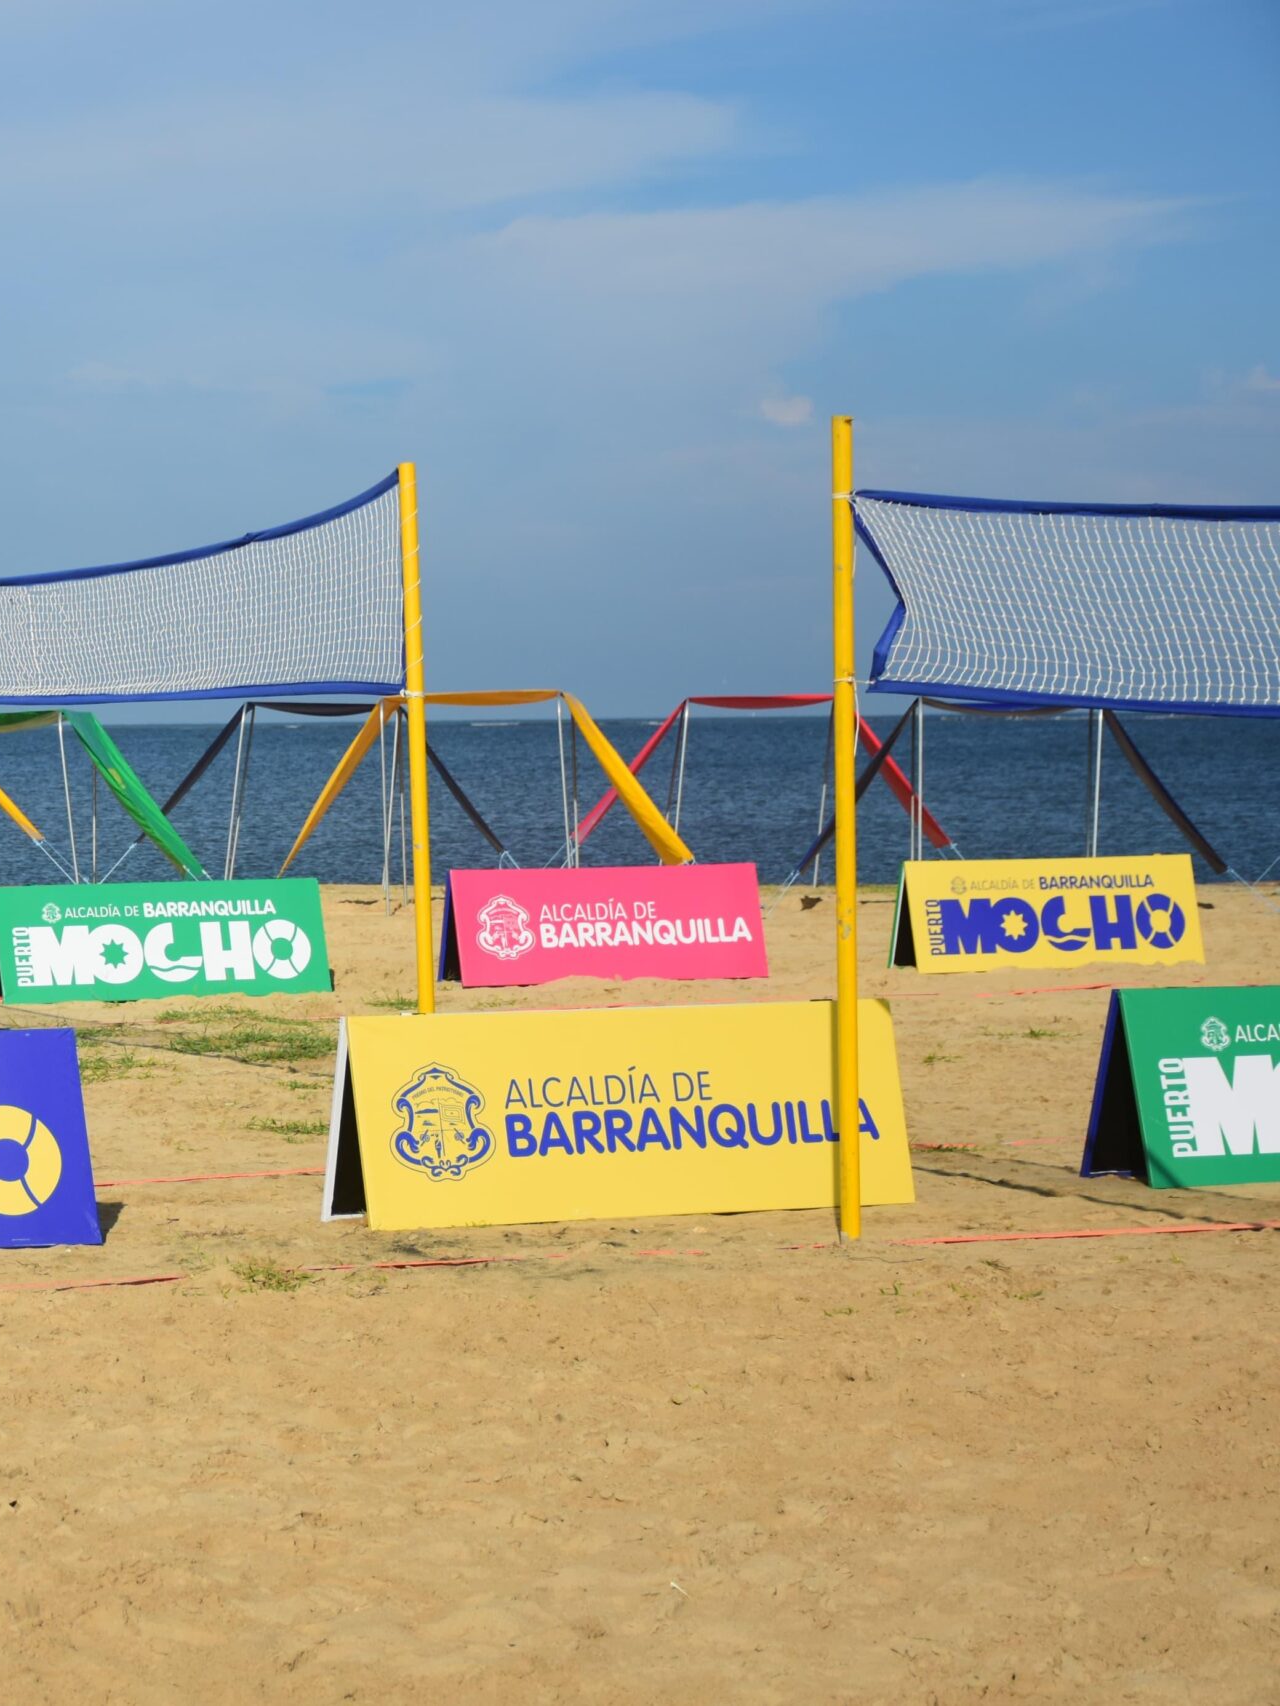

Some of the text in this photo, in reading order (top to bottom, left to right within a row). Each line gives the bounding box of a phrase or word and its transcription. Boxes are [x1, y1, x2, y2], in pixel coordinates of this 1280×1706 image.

[970, 874, 1154, 891] ALCALDÍA DE BARRANQUILLA
[64, 899, 276, 919] ALCALDÍA DE BARRANQUILLA
[539, 897, 656, 922] ALCALDÍA DE
[926, 900, 945, 955] PUERTO
[940, 893, 1186, 955] MOCHO
[28, 919, 311, 986] MOCHO
[539, 917, 752, 948] BARRANQUILLA
[12, 927, 35, 987] PUERTO
[1235, 1022, 1280, 1044] ALCA
[505, 1066, 713, 1109] ALCALDÍA DE
[1158, 1058, 1198, 1157] PUERTO
